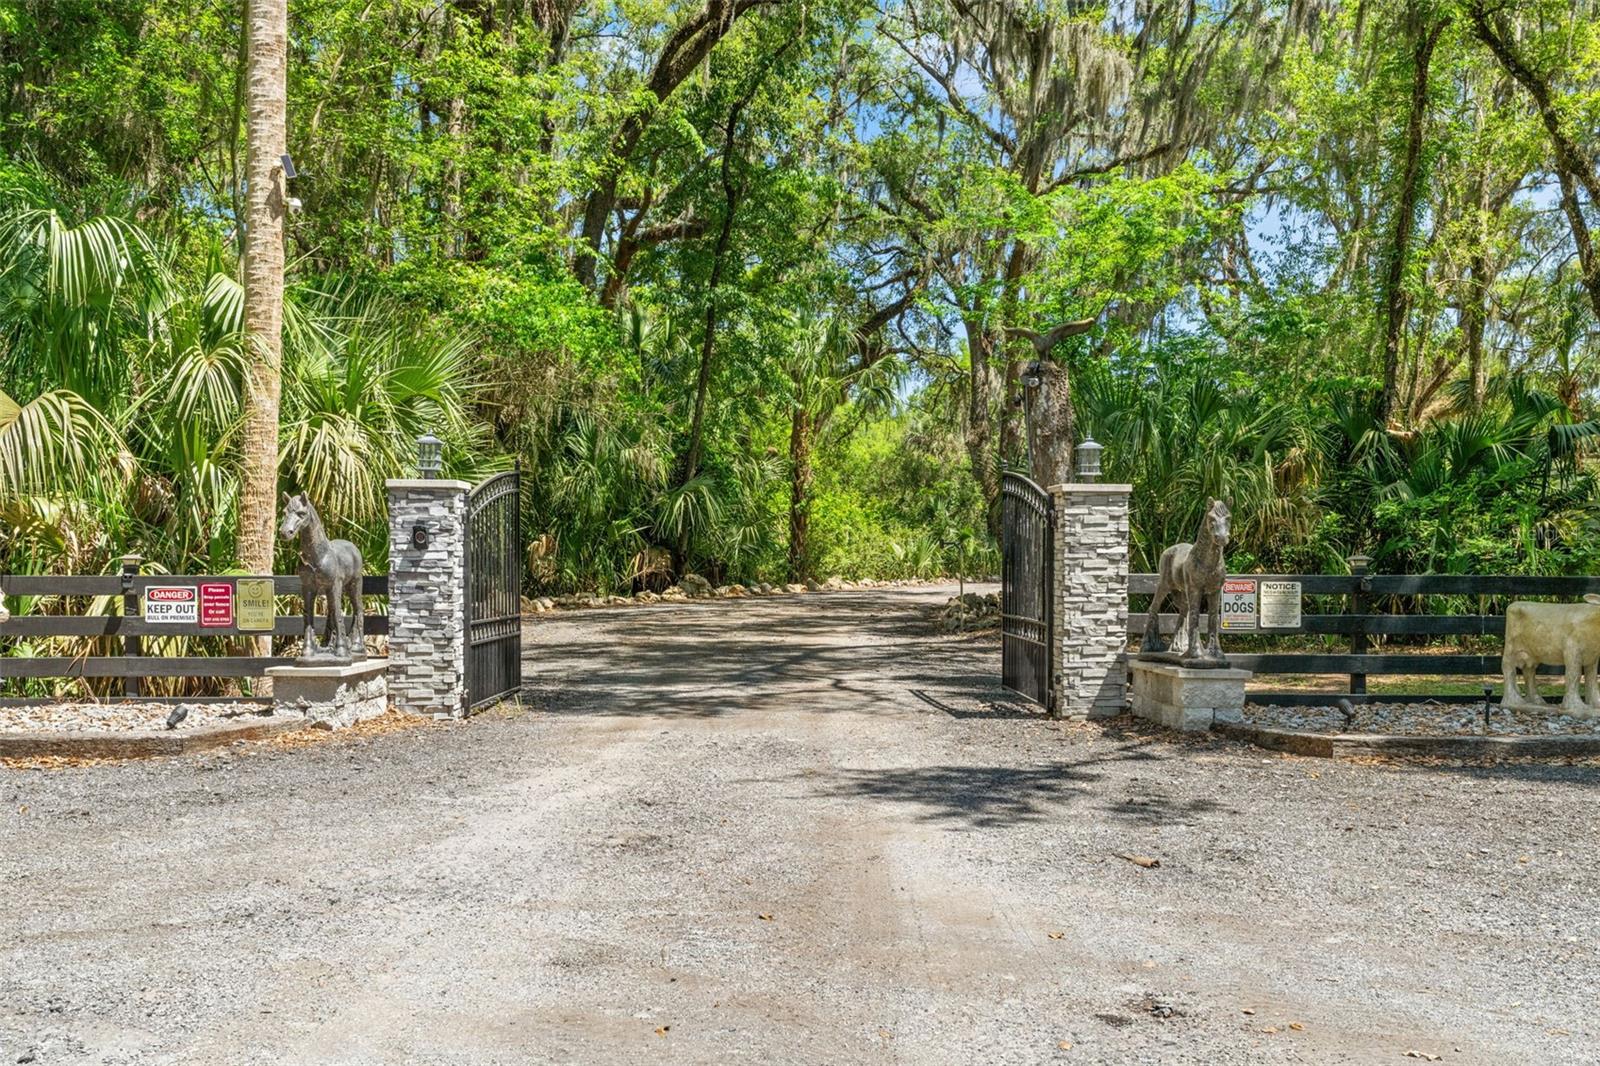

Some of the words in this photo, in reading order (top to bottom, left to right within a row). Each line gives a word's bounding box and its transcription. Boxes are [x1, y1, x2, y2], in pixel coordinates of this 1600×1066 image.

[154, 591, 189, 599] DANGER
[242, 599, 269, 607] SMILE!
[147, 604, 172, 613] KEEP
[175, 604, 195, 613] OUT
[1224, 602, 1254, 613] DOGS
